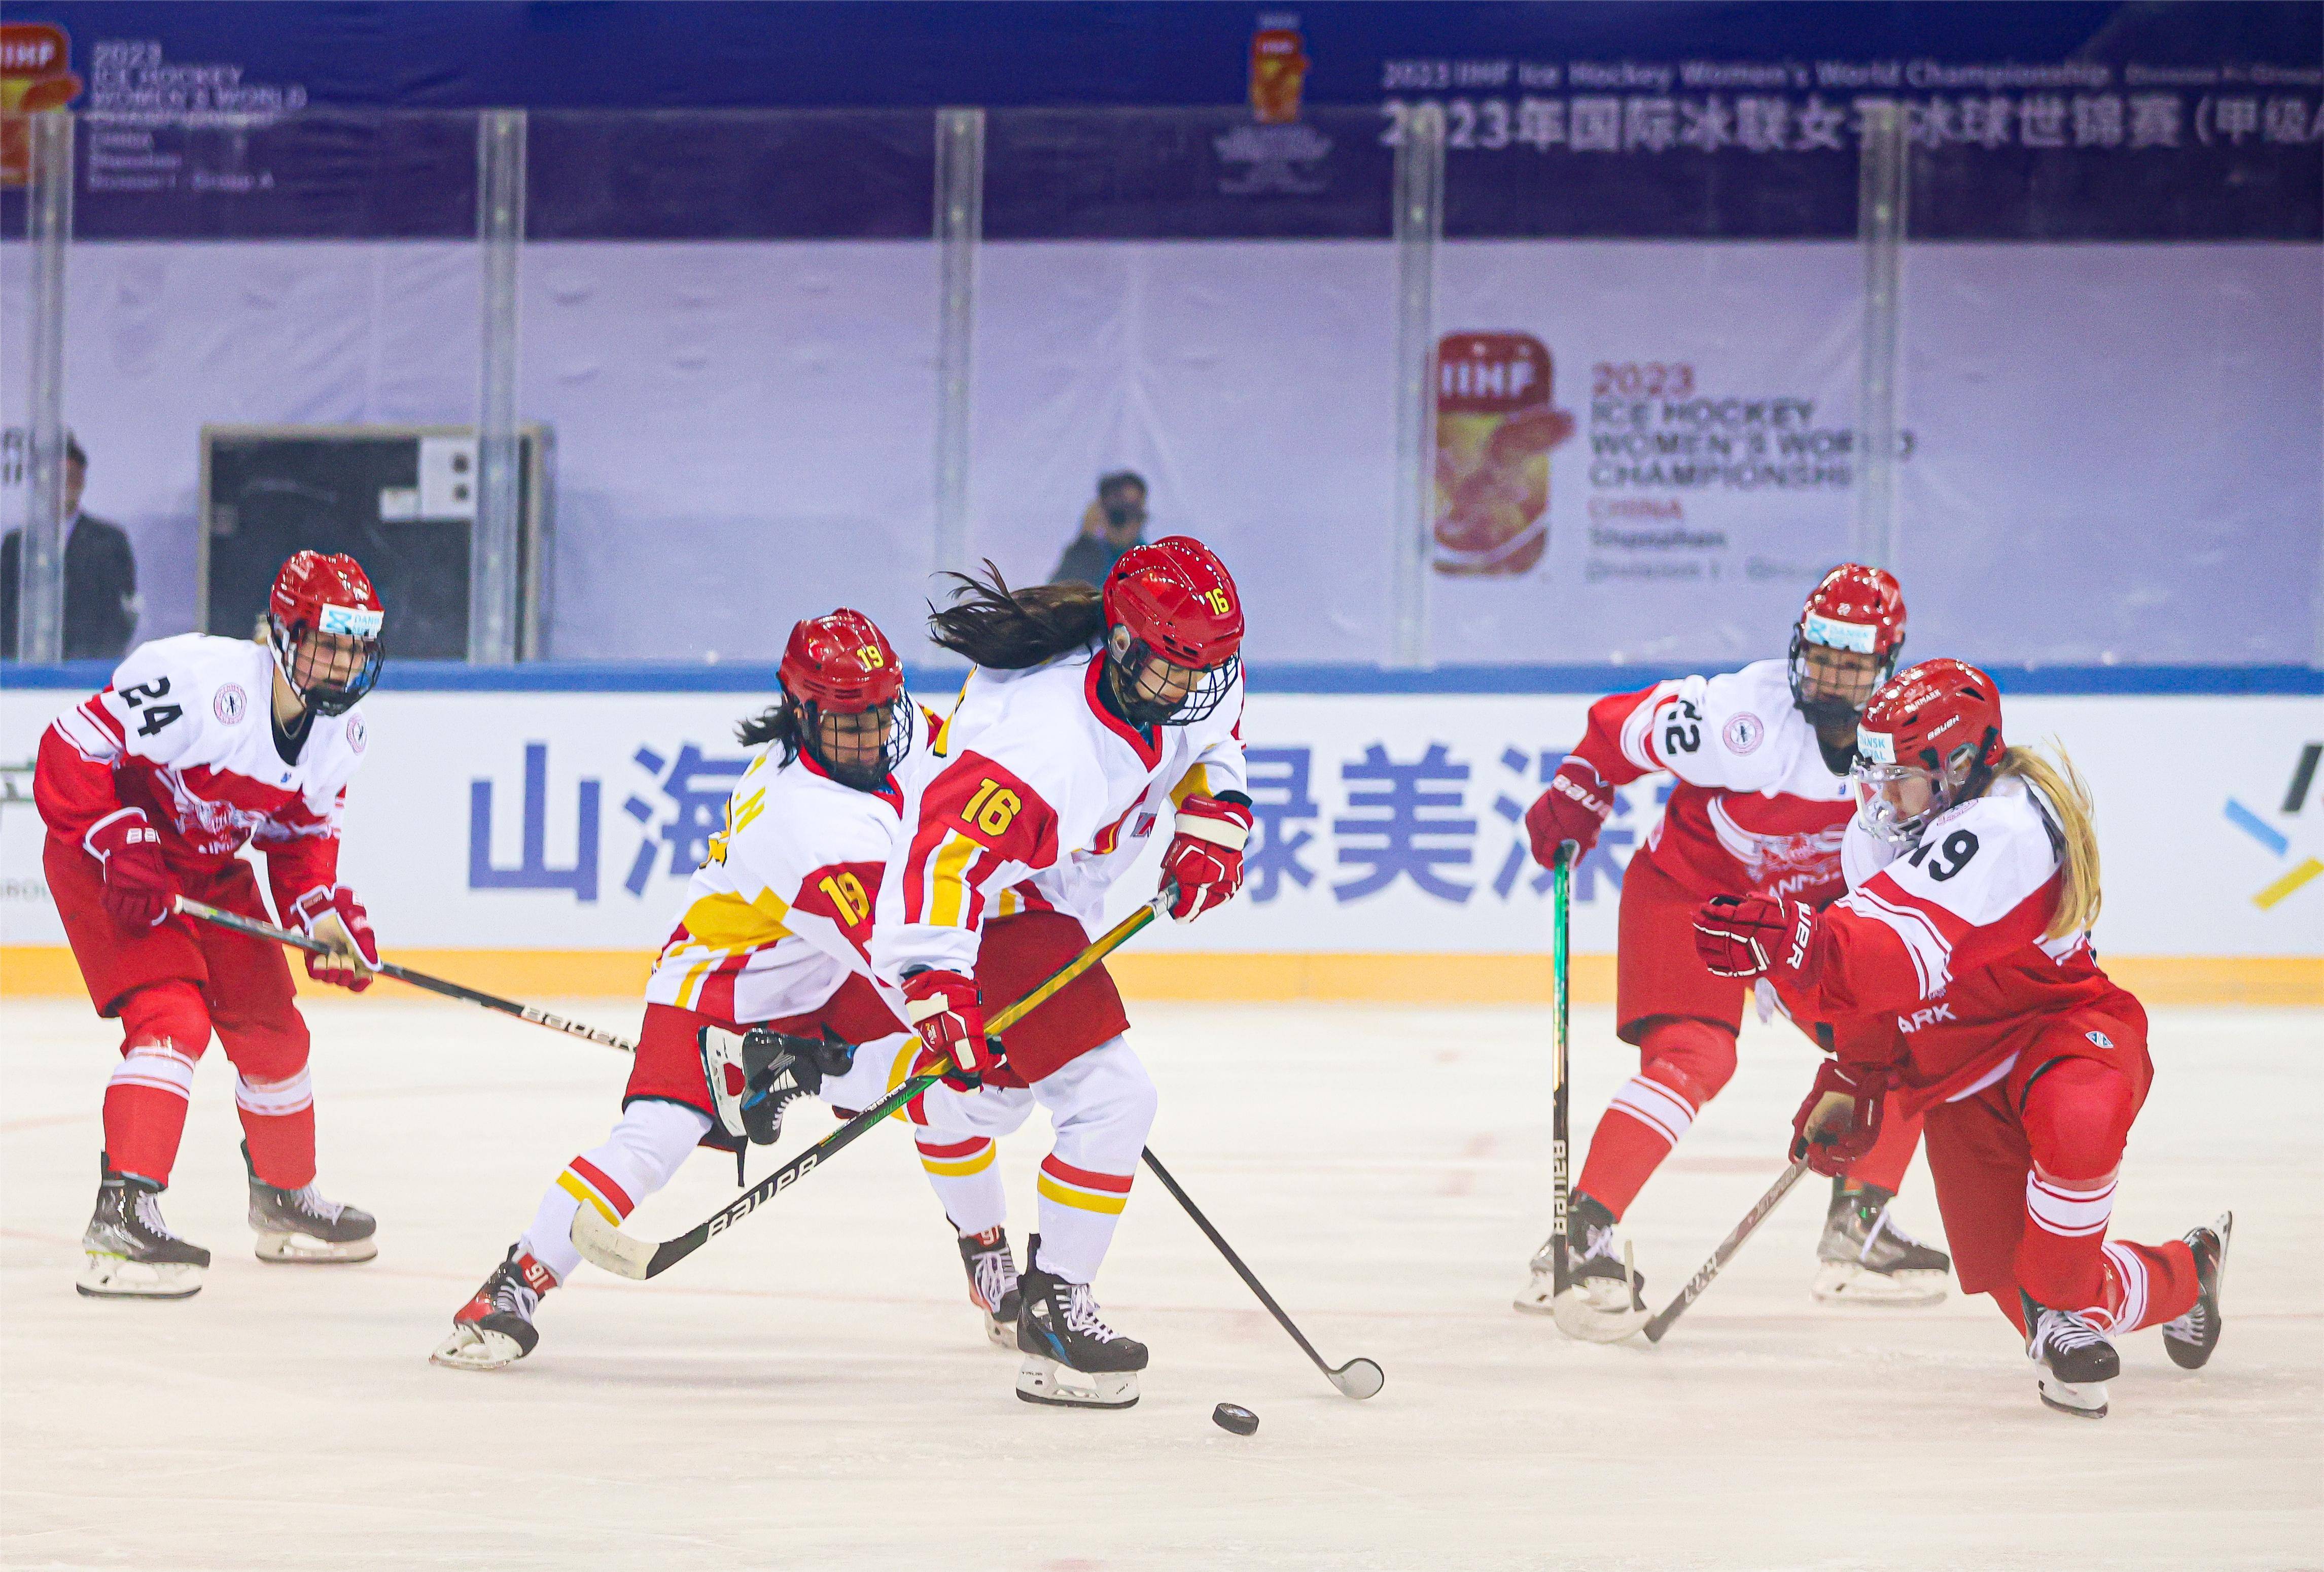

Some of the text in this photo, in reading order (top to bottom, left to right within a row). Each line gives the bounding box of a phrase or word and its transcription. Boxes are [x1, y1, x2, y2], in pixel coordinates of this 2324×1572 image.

[1592, 361, 1695, 398] 2023
[1662, 398, 1816, 429] HOCKEY
[1589, 462, 1853, 488] CHAMPIONSHI
[1205, 588, 1230, 616] 16
[856, 644, 885, 671] 19
[118, 675, 183, 738] 24
[961, 778, 1023, 837] 16
[126, 827, 161, 845] BA
[819, 871, 871, 928] 19
[1553, 1139, 1567, 1235] BAUER
